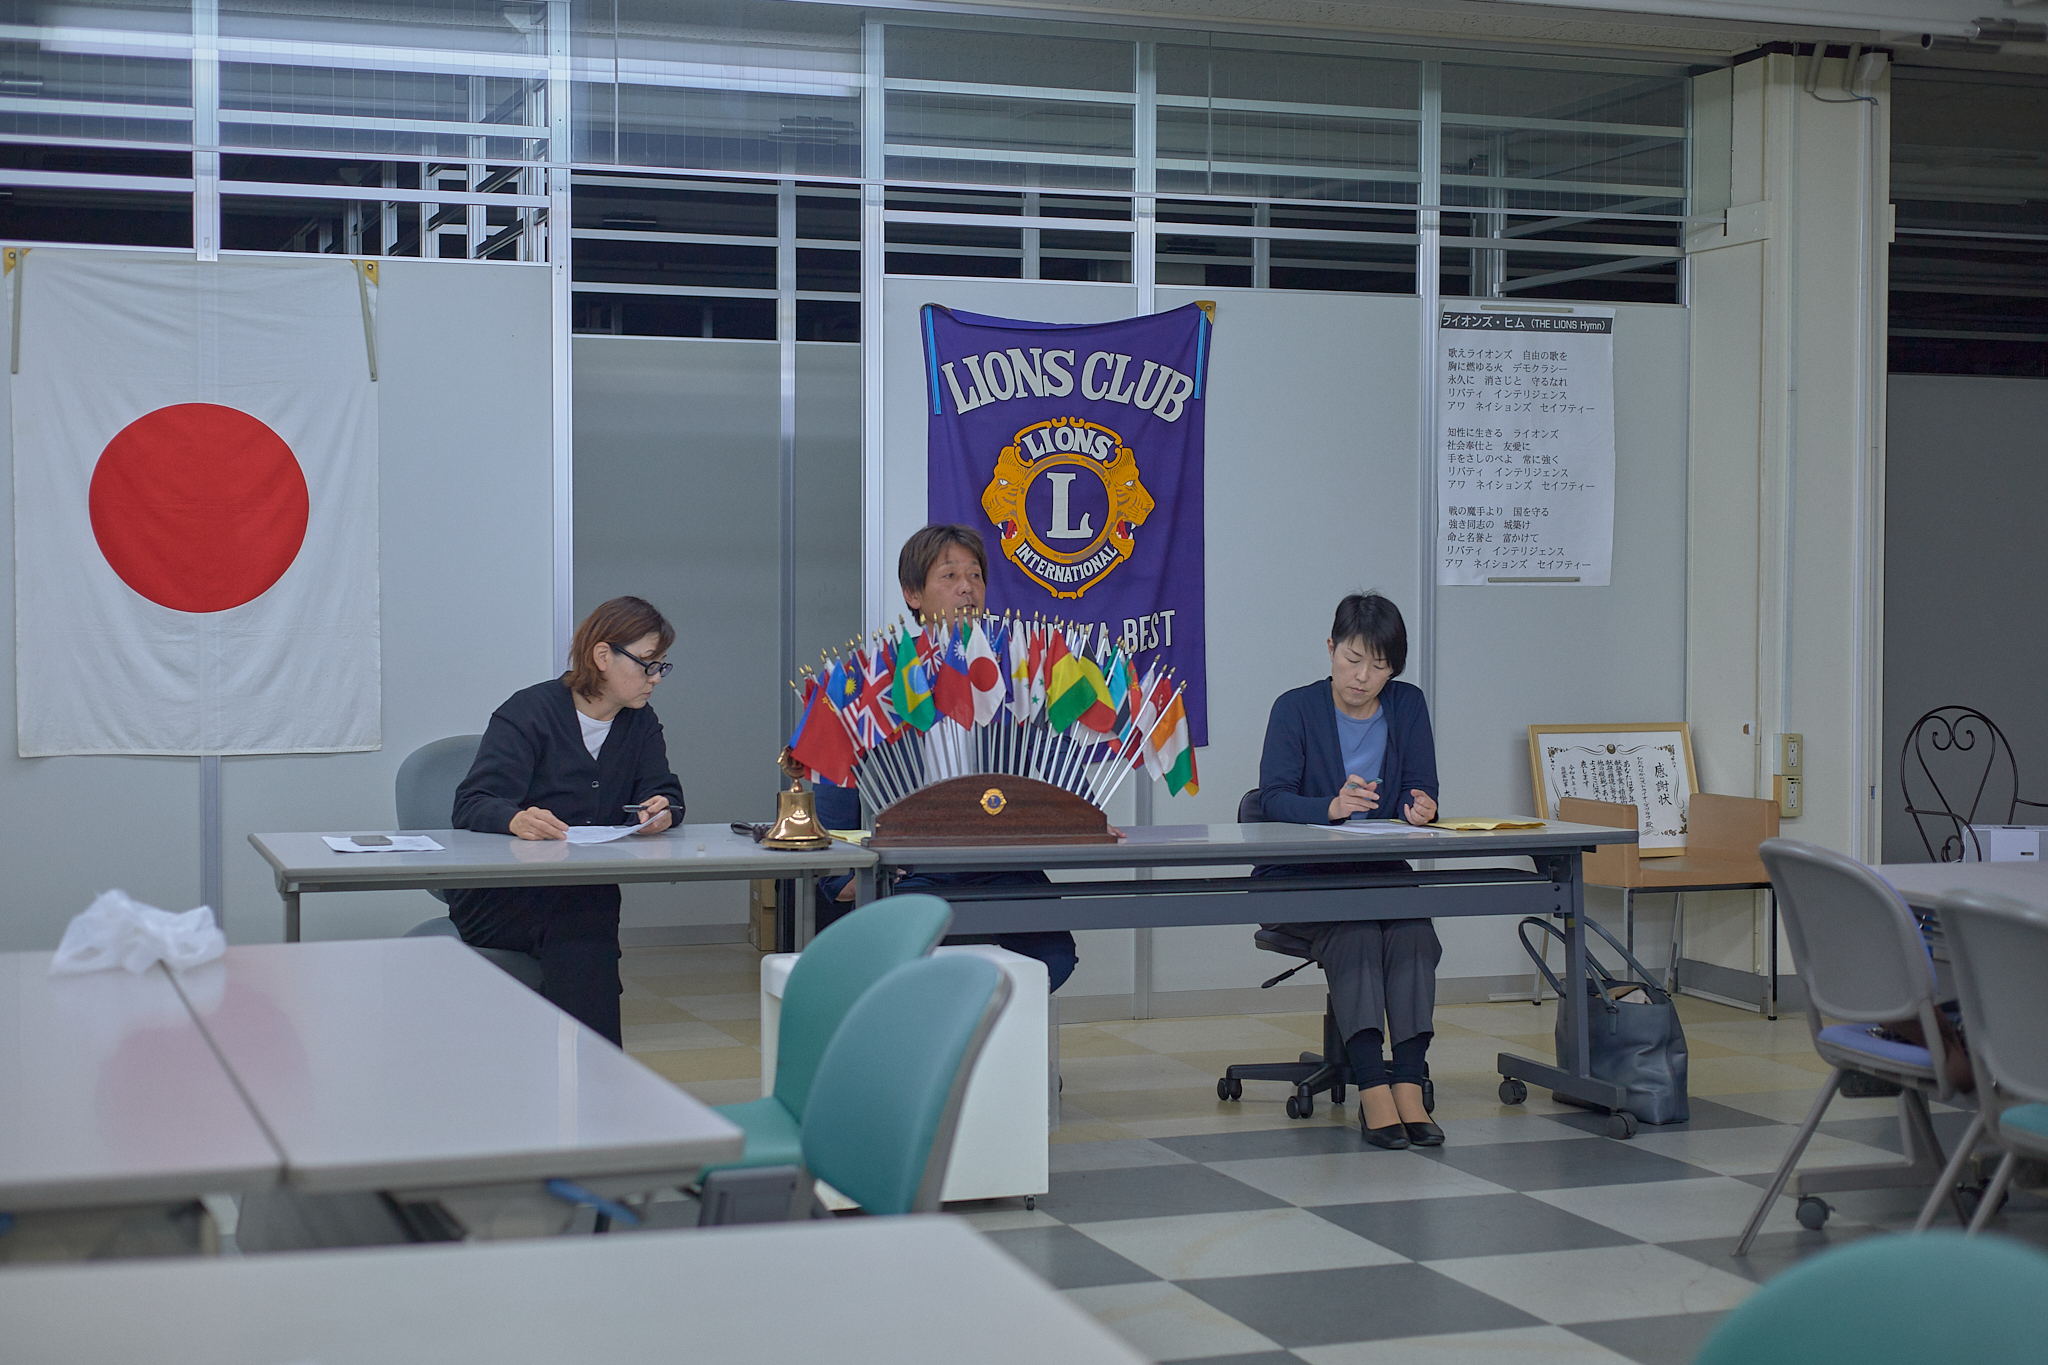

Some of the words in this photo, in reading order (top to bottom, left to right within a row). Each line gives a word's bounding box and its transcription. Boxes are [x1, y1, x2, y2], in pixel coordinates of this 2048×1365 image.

[1554, 321, 1577, 330] LIONS
[1448, 348, 1512, 359] 歌えライオンズ
[1523, 350, 1568, 361] 自由の歌を
[1448, 362, 1503, 372] 胸に燃ゆる火
[1513, 363, 1568, 373] デモクラシー
[941, 348, 1074, 415] LIONS
[1081, 351, 1194, 422] CLUB
[1448, 375, 1475, 385] 永久に
[1485, 375, 1522, 385] 消さじと
[1532, 377, 1568, 387] 守るなれ
[1494, 389, 1567, 400] インテリジェンス
[1448, 402, 1465, 410] アワ
[1476, 402, 1531, 412] ネイションズ
[1540, 403, 1595, 413] セイフティー
[1448, 427, 1503, 438] 知性に生きる
[1514, 429, 1559, 439] ライオンズ
[1022, 427, 1114, 460] LIONS
[1447, 440, 1493, 450] 社会奉仕と
[1503, 441, 1530, 451] 友愛に
[1448, 454, 1512, 463] 手をさしのべよ
[1523, 455, 1559, 464] 常に強く
[1495, 468, 1568, 477] インテリジェンス
[1448, 480, 1466, 489] アワ
[1476, 480, 1532, 490] ネイションズ
[1542, 481, 1594, 491] セイフティー
[1047, 472, 1093, 538] L
[1448, 506, 1503, 516] 戦の魔手より
[1514, 507, 1549, 517] 国を守る
[1449, 519, 1494, 529] 強き同志の
[1504, 520, 1530, 529] 城築け
[1448, 532, 1493, 542] 命と名誉と
[1503, 533, 1539, 543] 富かけて
[1493, 547, 1565, 556] インテリジェンス
[1016, 542, 1119, 583] INTERNATIONAL
[1445, 559, 1463, 568] アワ
[1474, 559, 1528, 569] ネイションズ
[1538, 560, 1591, 570] セイフティー
[1123, 609, 1176, 655] BEST
[1655, 762, 1673, 806] 感謝状
